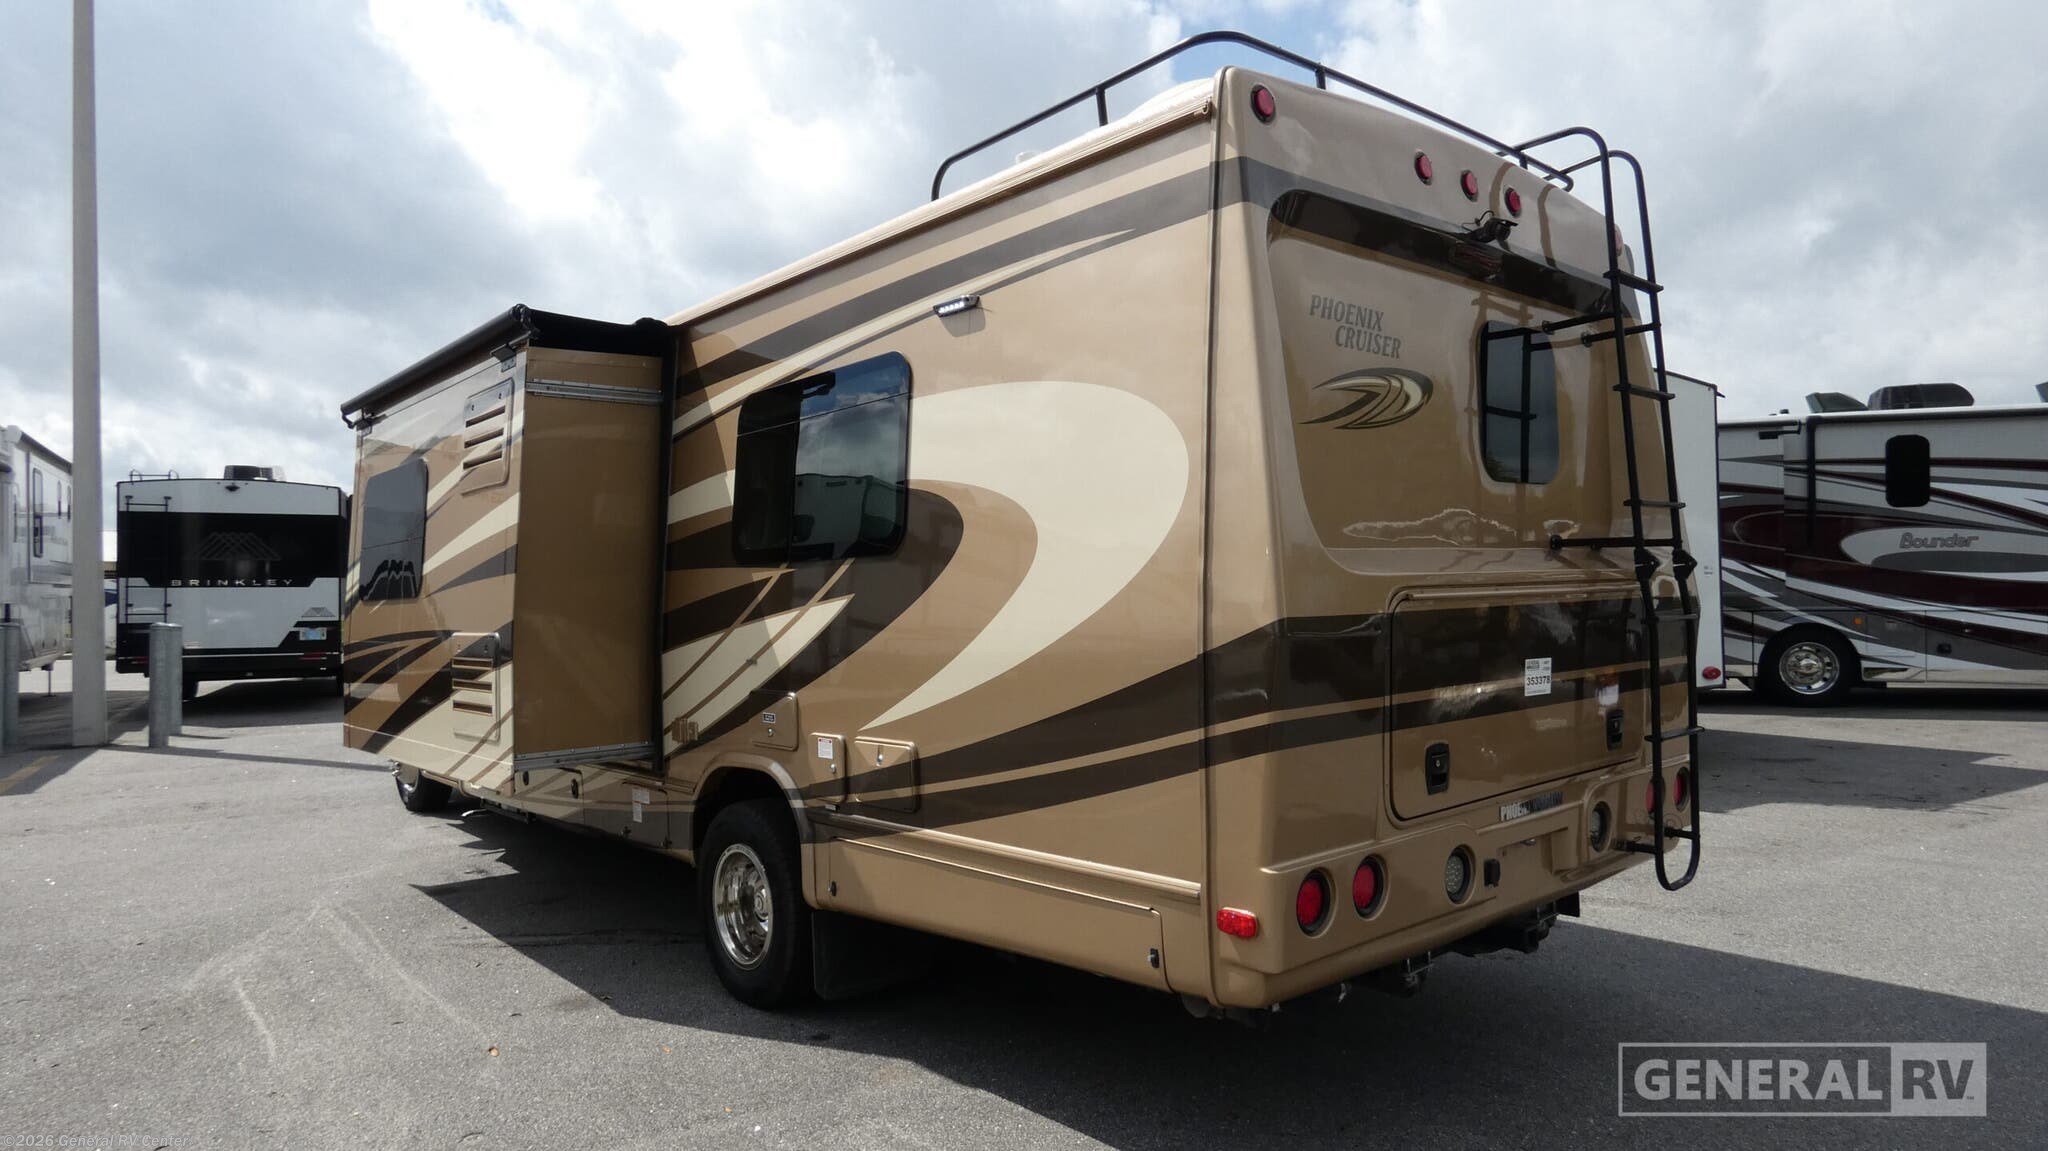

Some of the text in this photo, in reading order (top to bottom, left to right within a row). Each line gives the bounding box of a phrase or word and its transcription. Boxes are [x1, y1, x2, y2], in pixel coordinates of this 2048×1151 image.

[1309, 294, 1384, 332] PHOENIX
[1335, 325, 1402, 359] CRUISER
[1899, 532, 1979, 548] Bounder
[171, 579, 293, 587] BRINKLEY
